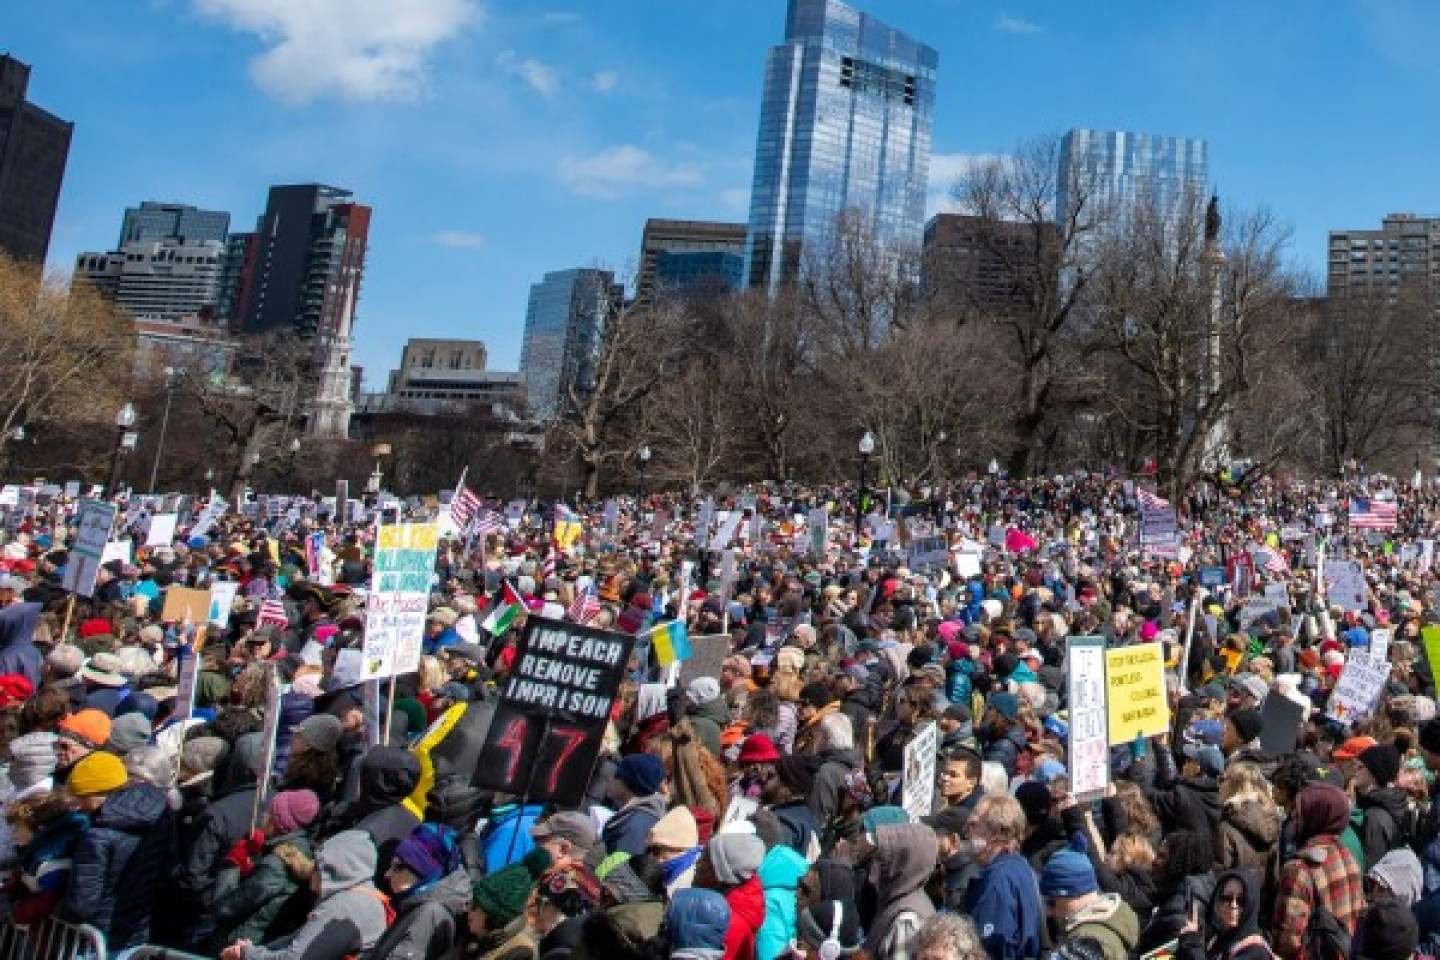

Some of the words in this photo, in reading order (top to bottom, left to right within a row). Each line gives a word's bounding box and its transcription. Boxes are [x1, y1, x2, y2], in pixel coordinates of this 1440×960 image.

[528, 626, 623, 665] IMPEACH
[520, 654, 601, 690] REMOVE
[505, 678, 611, 718] IMPRISON
[496, 715, 588, 792] 47
